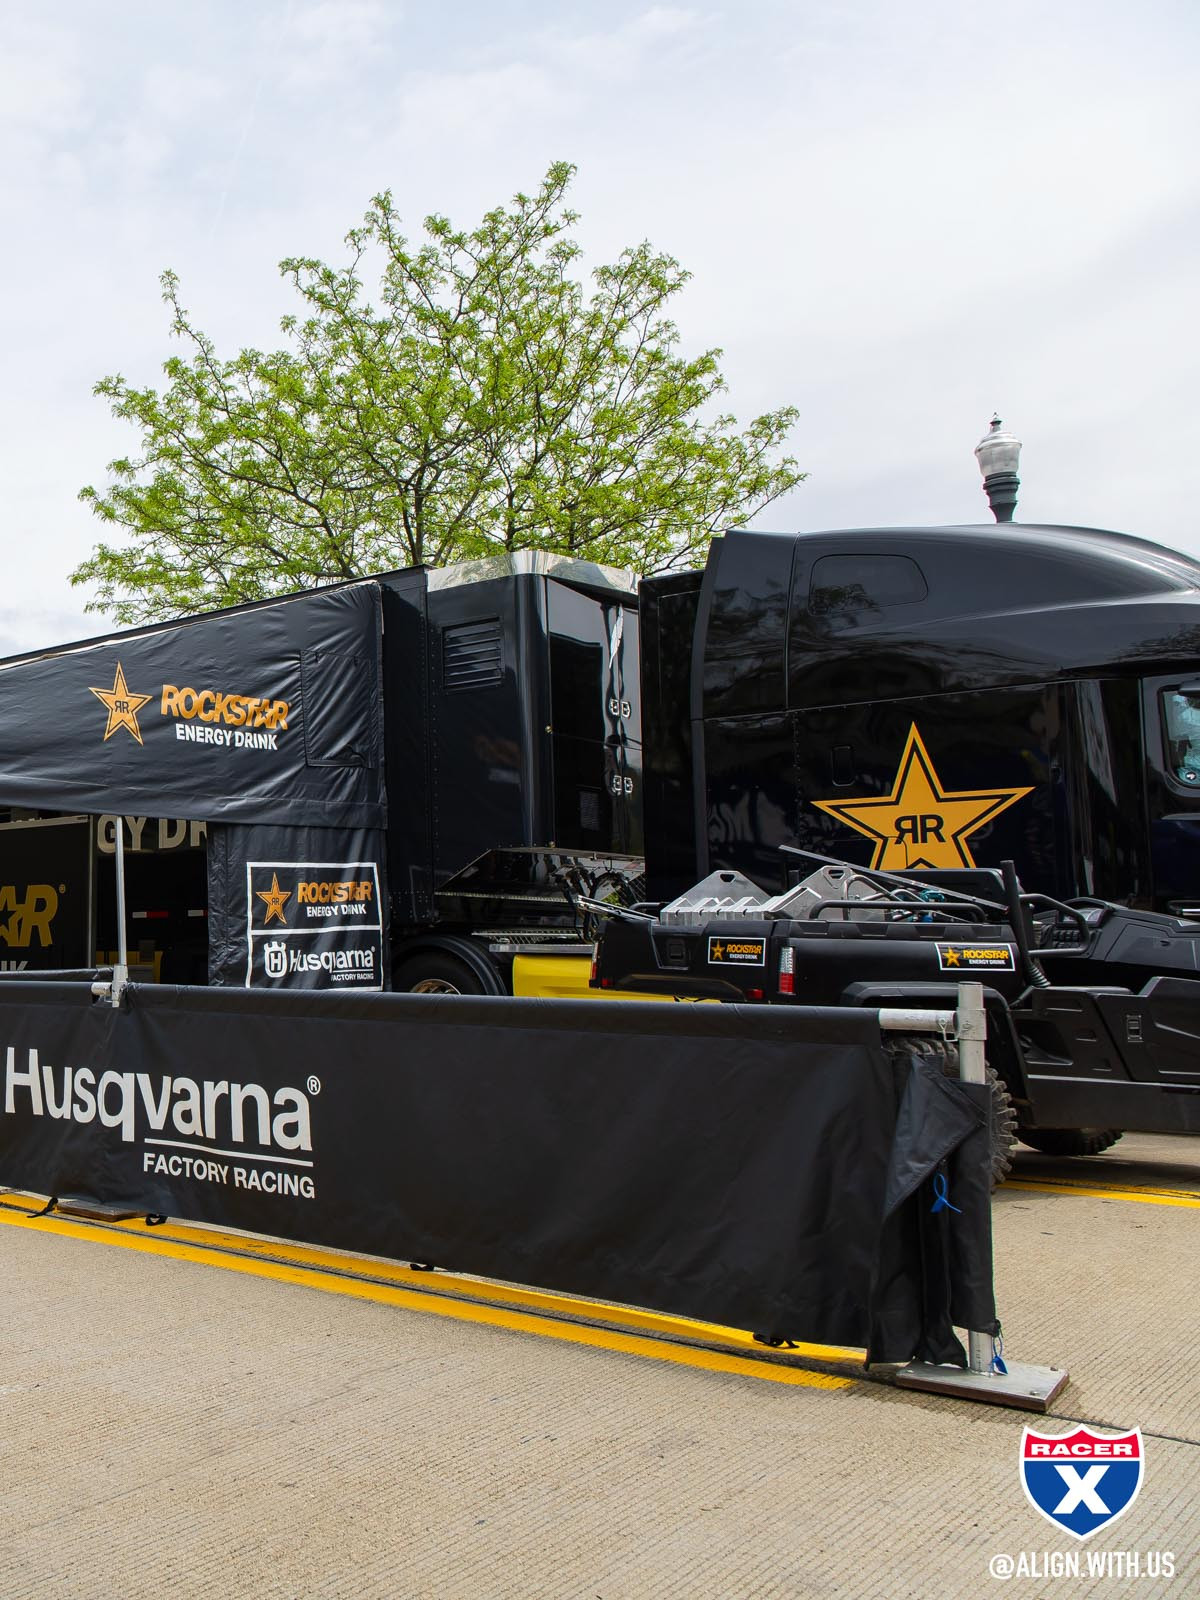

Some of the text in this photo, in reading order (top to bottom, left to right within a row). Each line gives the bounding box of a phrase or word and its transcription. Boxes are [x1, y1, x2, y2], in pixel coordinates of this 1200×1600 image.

[161, 684, 289, 730] ROCKSTAR
[175, 723, 278, 750] ENERGY DRINK
[306, 905, 338, 917] ENERGY
[726, 944, 762, 954] ROCKSTAR
[963, 949, 1008, 959] ROCKSTAR
[143, 1152, 315, 1199] FACTORY RACING
